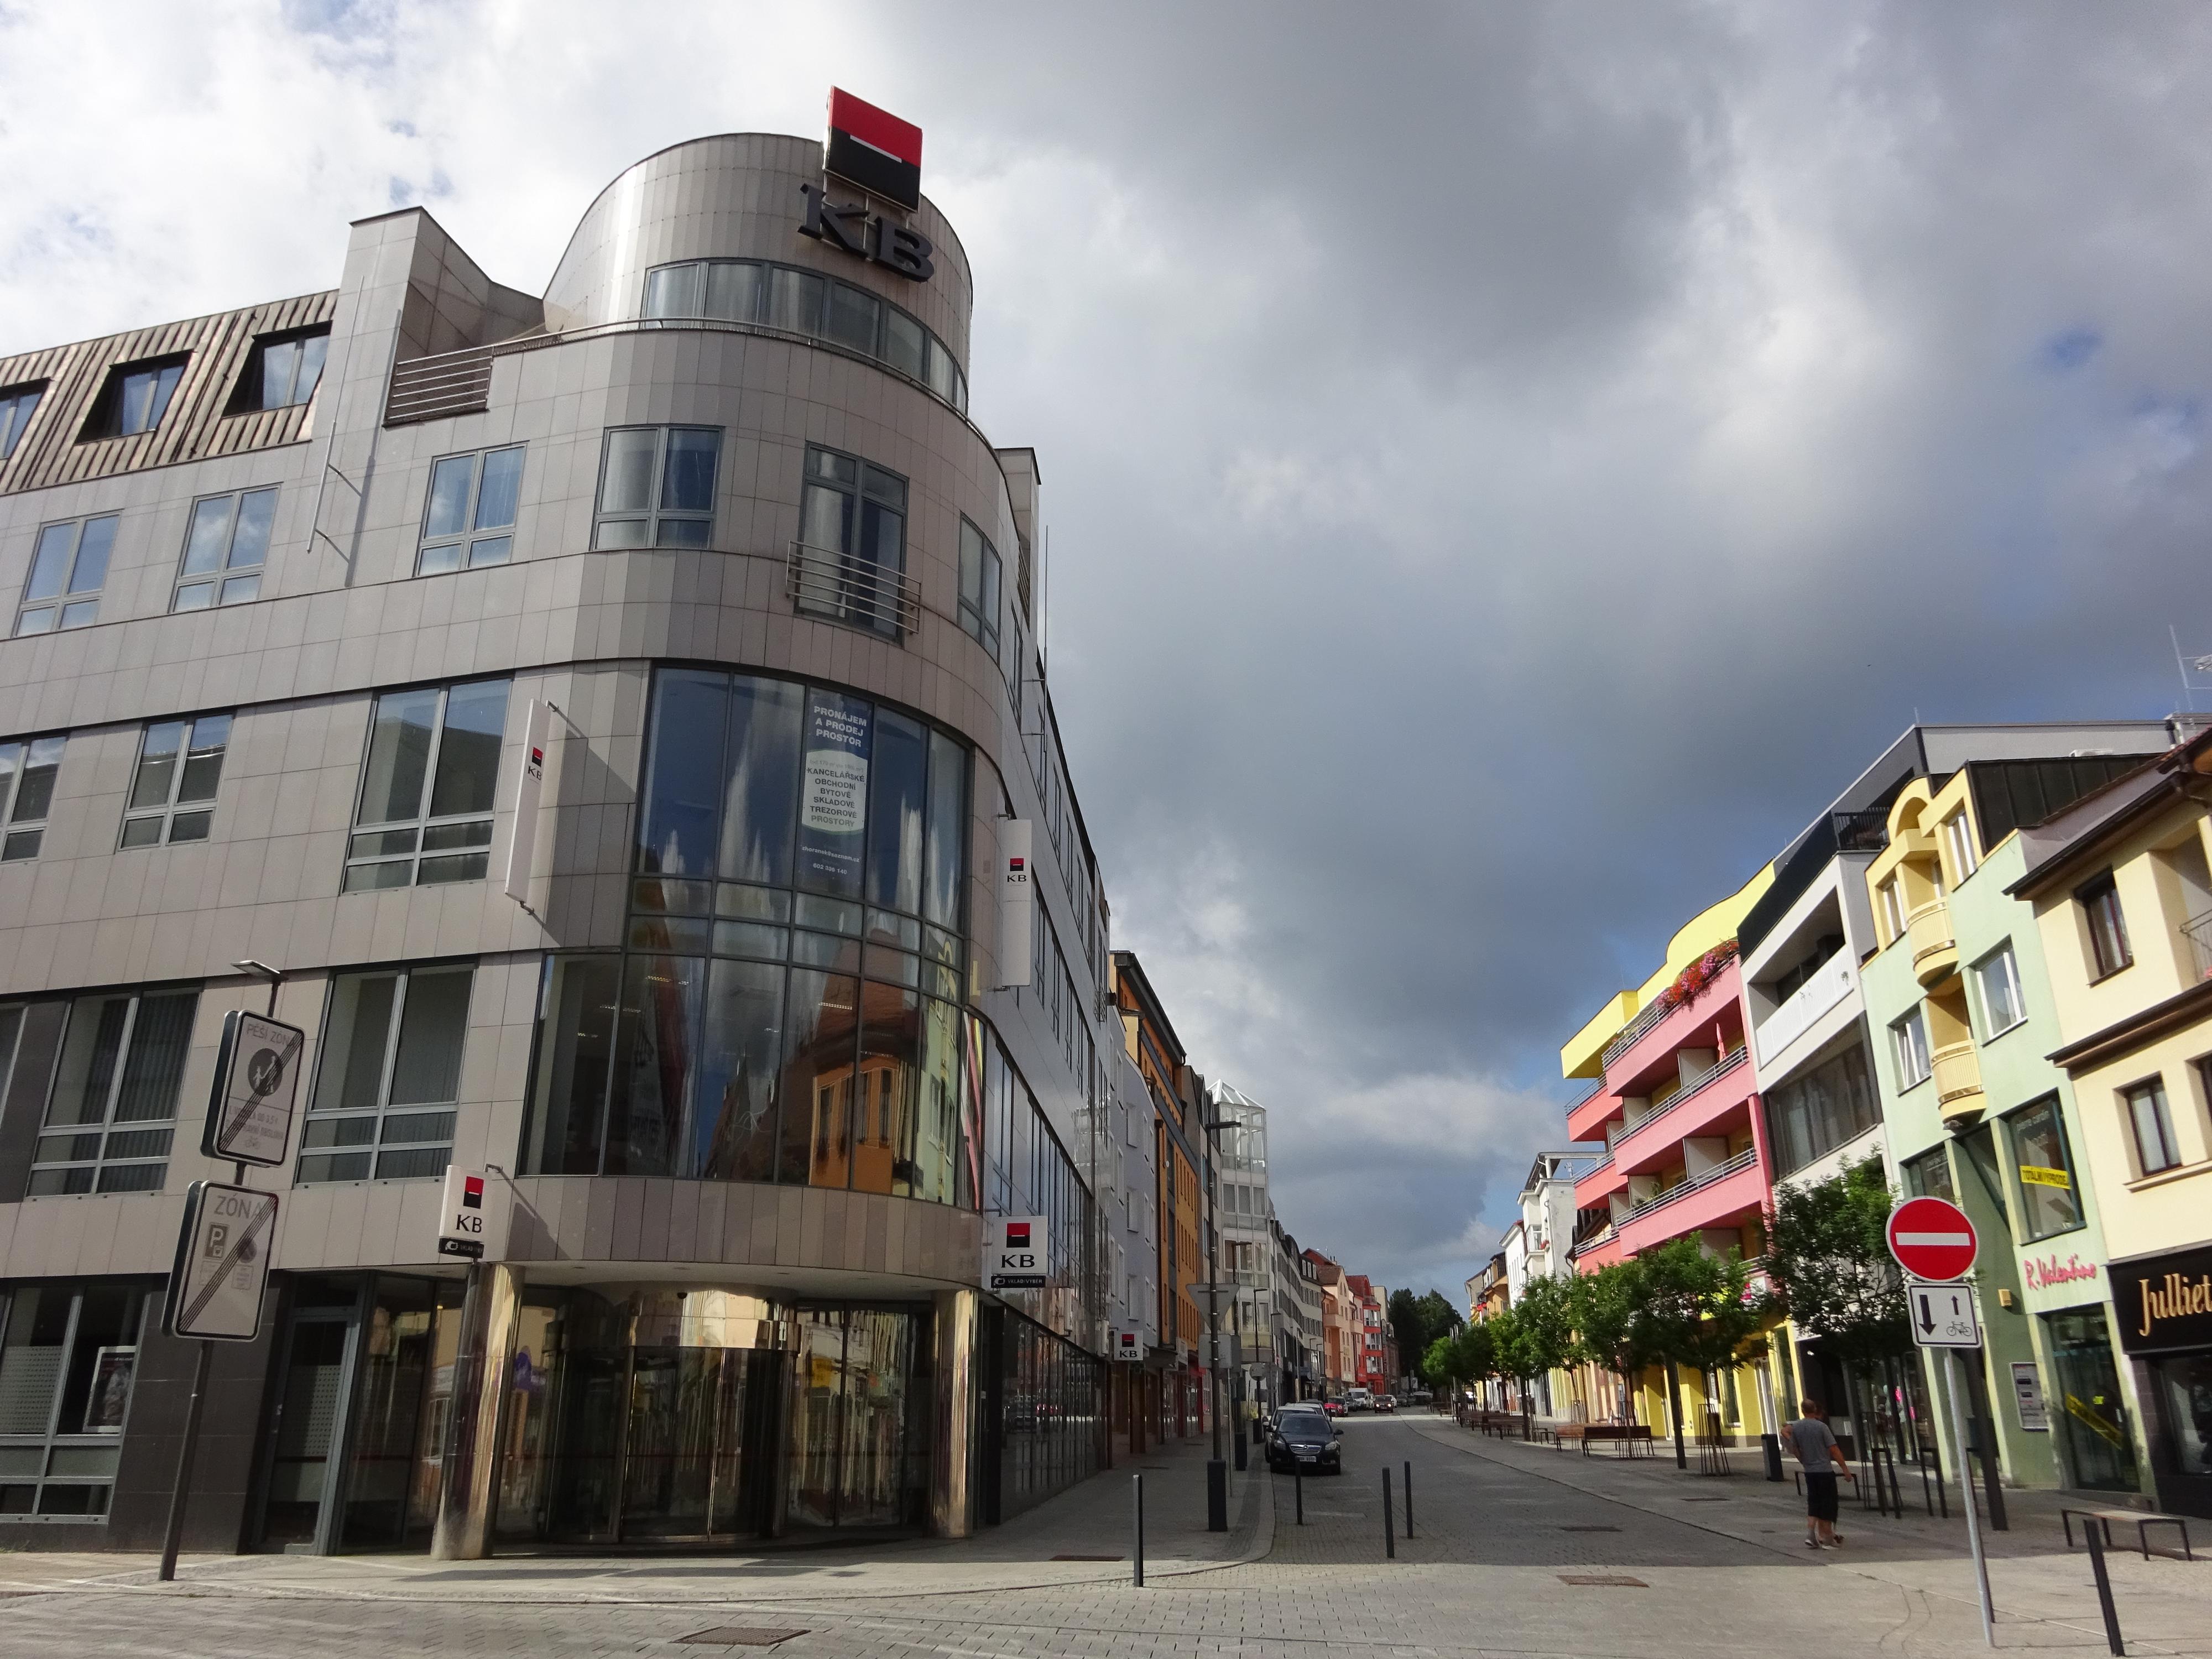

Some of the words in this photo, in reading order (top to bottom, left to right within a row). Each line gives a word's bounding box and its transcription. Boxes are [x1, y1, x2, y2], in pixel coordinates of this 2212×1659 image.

[797, 183, 935, 283] KB
[814, 706, 867, 727] PRONÁJEM
[826, 719, 863, 737] PRODEJ
[816, 728, 862, 747] PROSTOR
[528, 766, 542, 781] KB
[807, 768, 865, 782] KANCELÁŘSKÉ
[815, 778, 856, 790] OBCHODNÍ
[820, 788, 851, 798] BYTOVÉ
[813, 796, 855, 808] SKLADOVÉ
[810, 806, 857, 818] TREZOROVÉ
[811, 815, 855, 827] PROSTORY
[1007, 874, 1027, 883] KB
[456, 1214, 482, 1233] KB
[1000, 1254, 1035, 1268] KB
